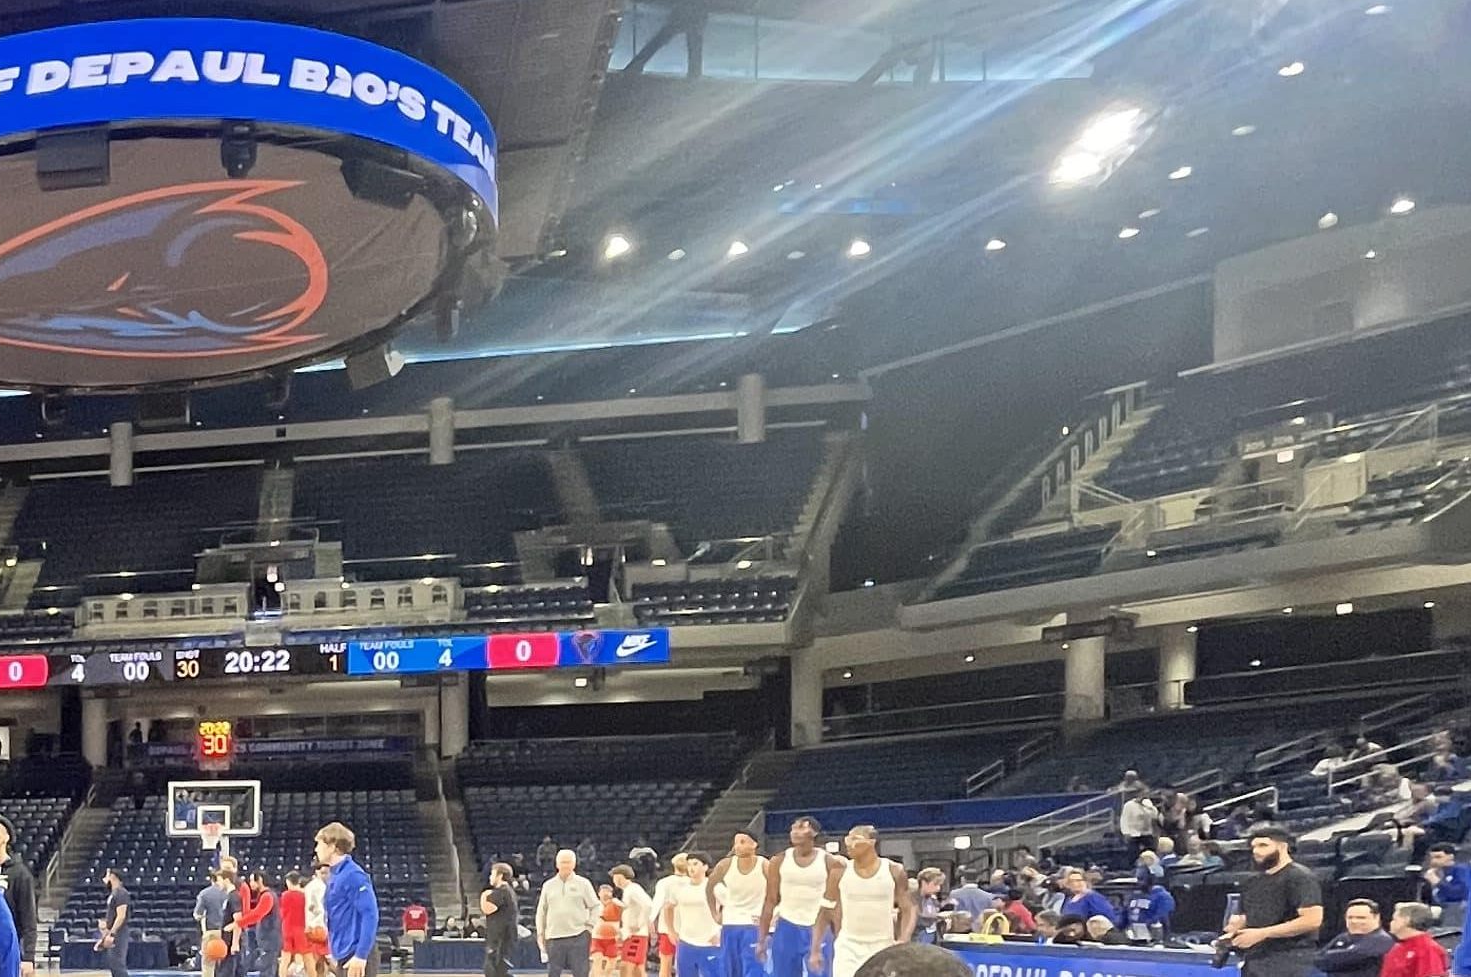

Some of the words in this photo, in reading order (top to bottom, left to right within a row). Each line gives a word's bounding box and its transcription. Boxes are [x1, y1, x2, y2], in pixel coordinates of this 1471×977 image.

[26, 50, 280, 95] DEPAUL
[319, 643, 347, 654] HALF
[328, 654, 338, 671] 1
[373, 651, 399, 670] 00
[438, 648, 453, 667] 4
[516, 640, 532, 661] 0
[8, 661, 23, 682] 0
[71, 663, 85, 682] 4
[123, 661, 150, 681] 00
[176, 660, 200, 678] 30
[224, 650, 290, 674] 20:22
[204, 735, 227, 754] 30
